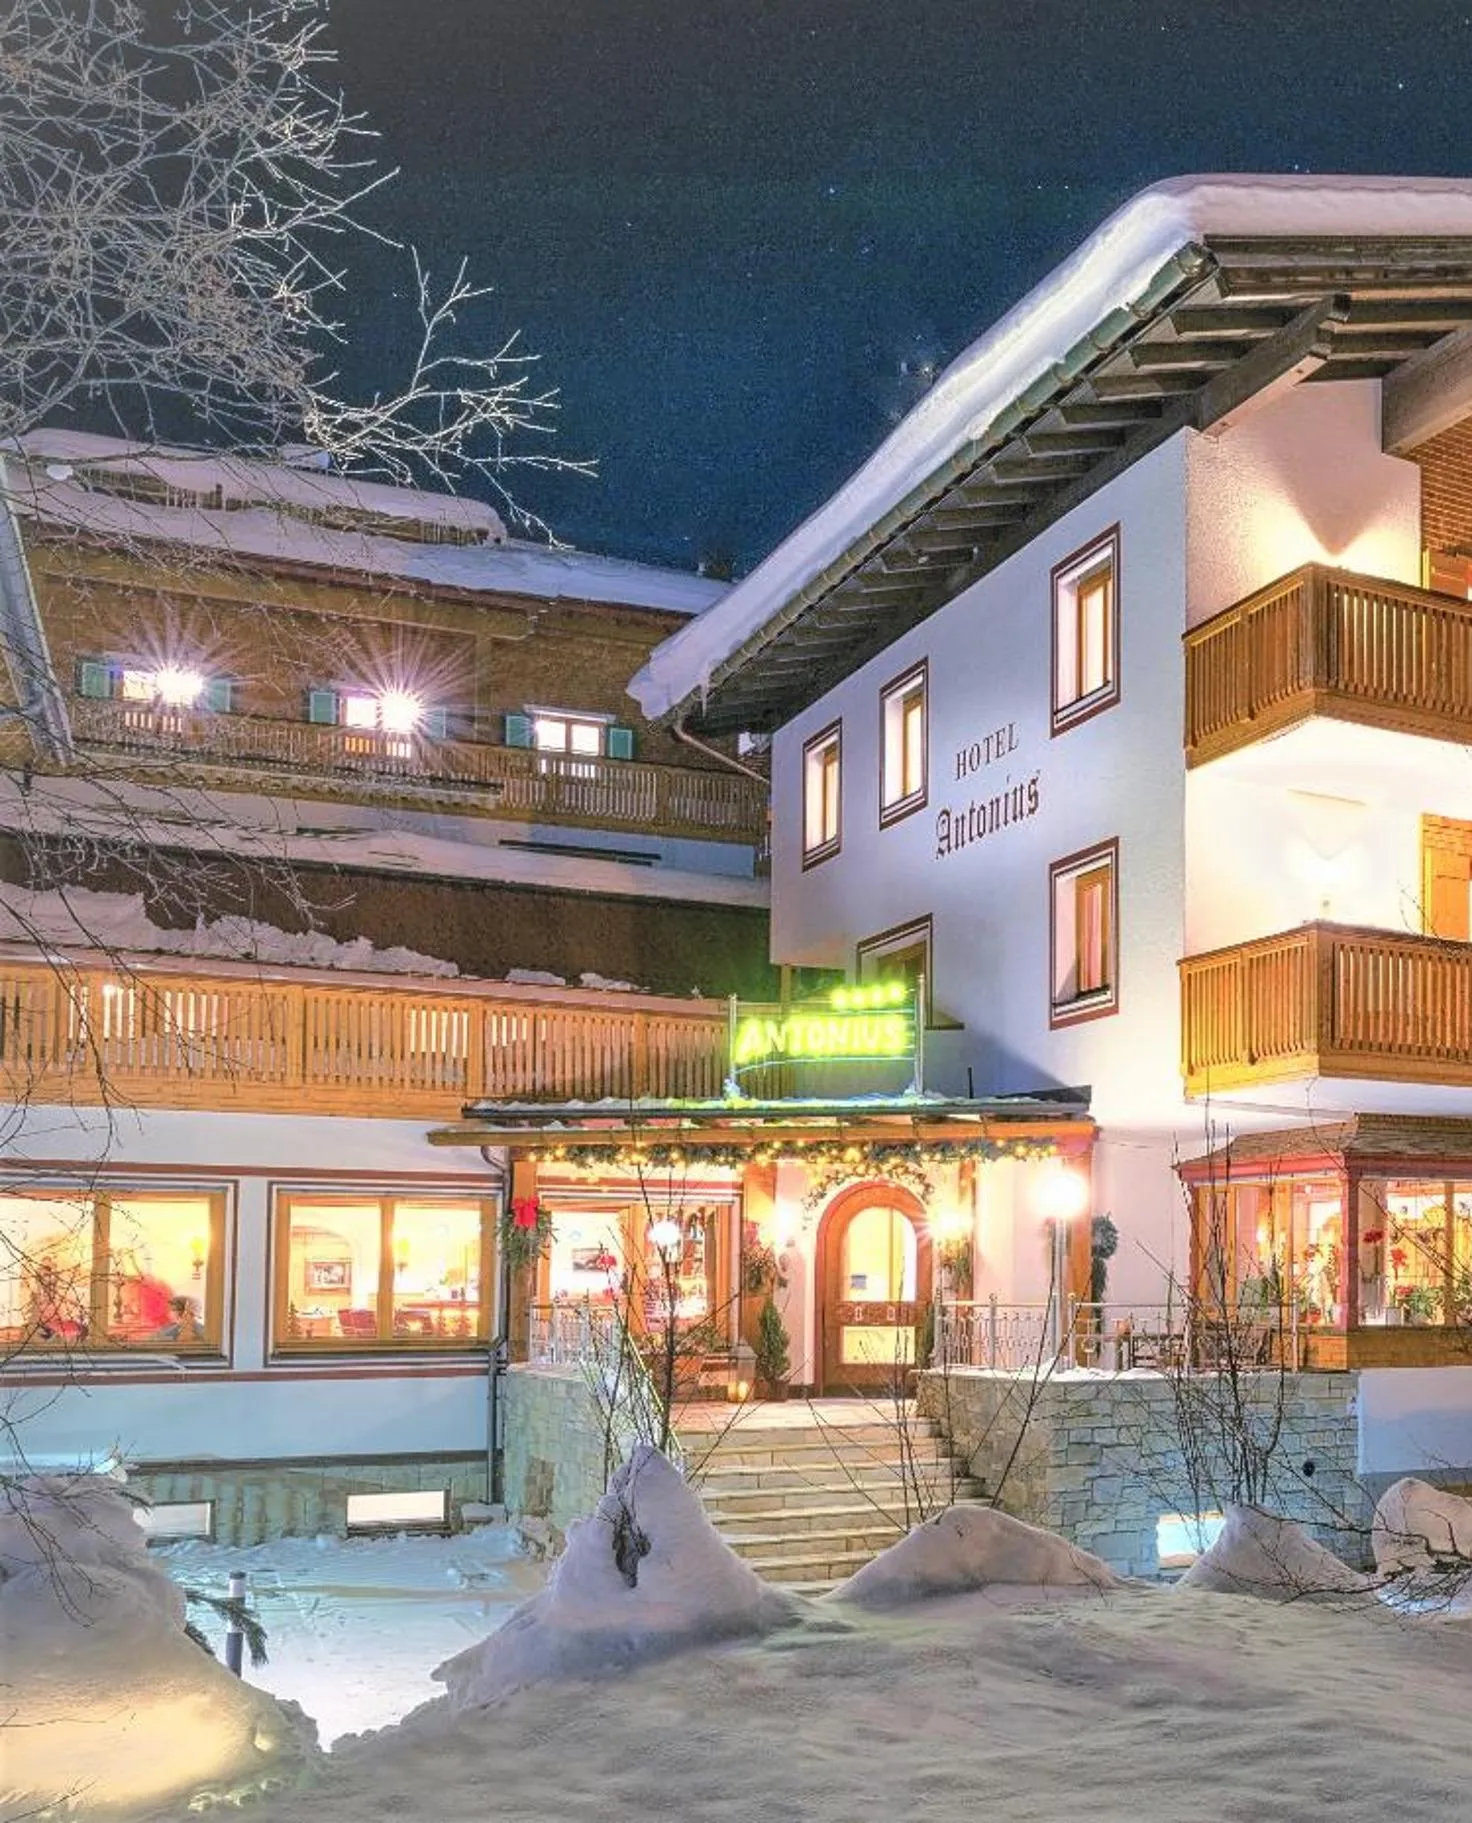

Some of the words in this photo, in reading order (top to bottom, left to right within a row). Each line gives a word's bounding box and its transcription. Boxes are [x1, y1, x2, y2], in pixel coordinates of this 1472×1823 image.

[954, 721, 1019, 781] HOTEL
[933, 769, 1041, 861] Antonius
[735, 1013, 908, 1065] ANTONIUS
